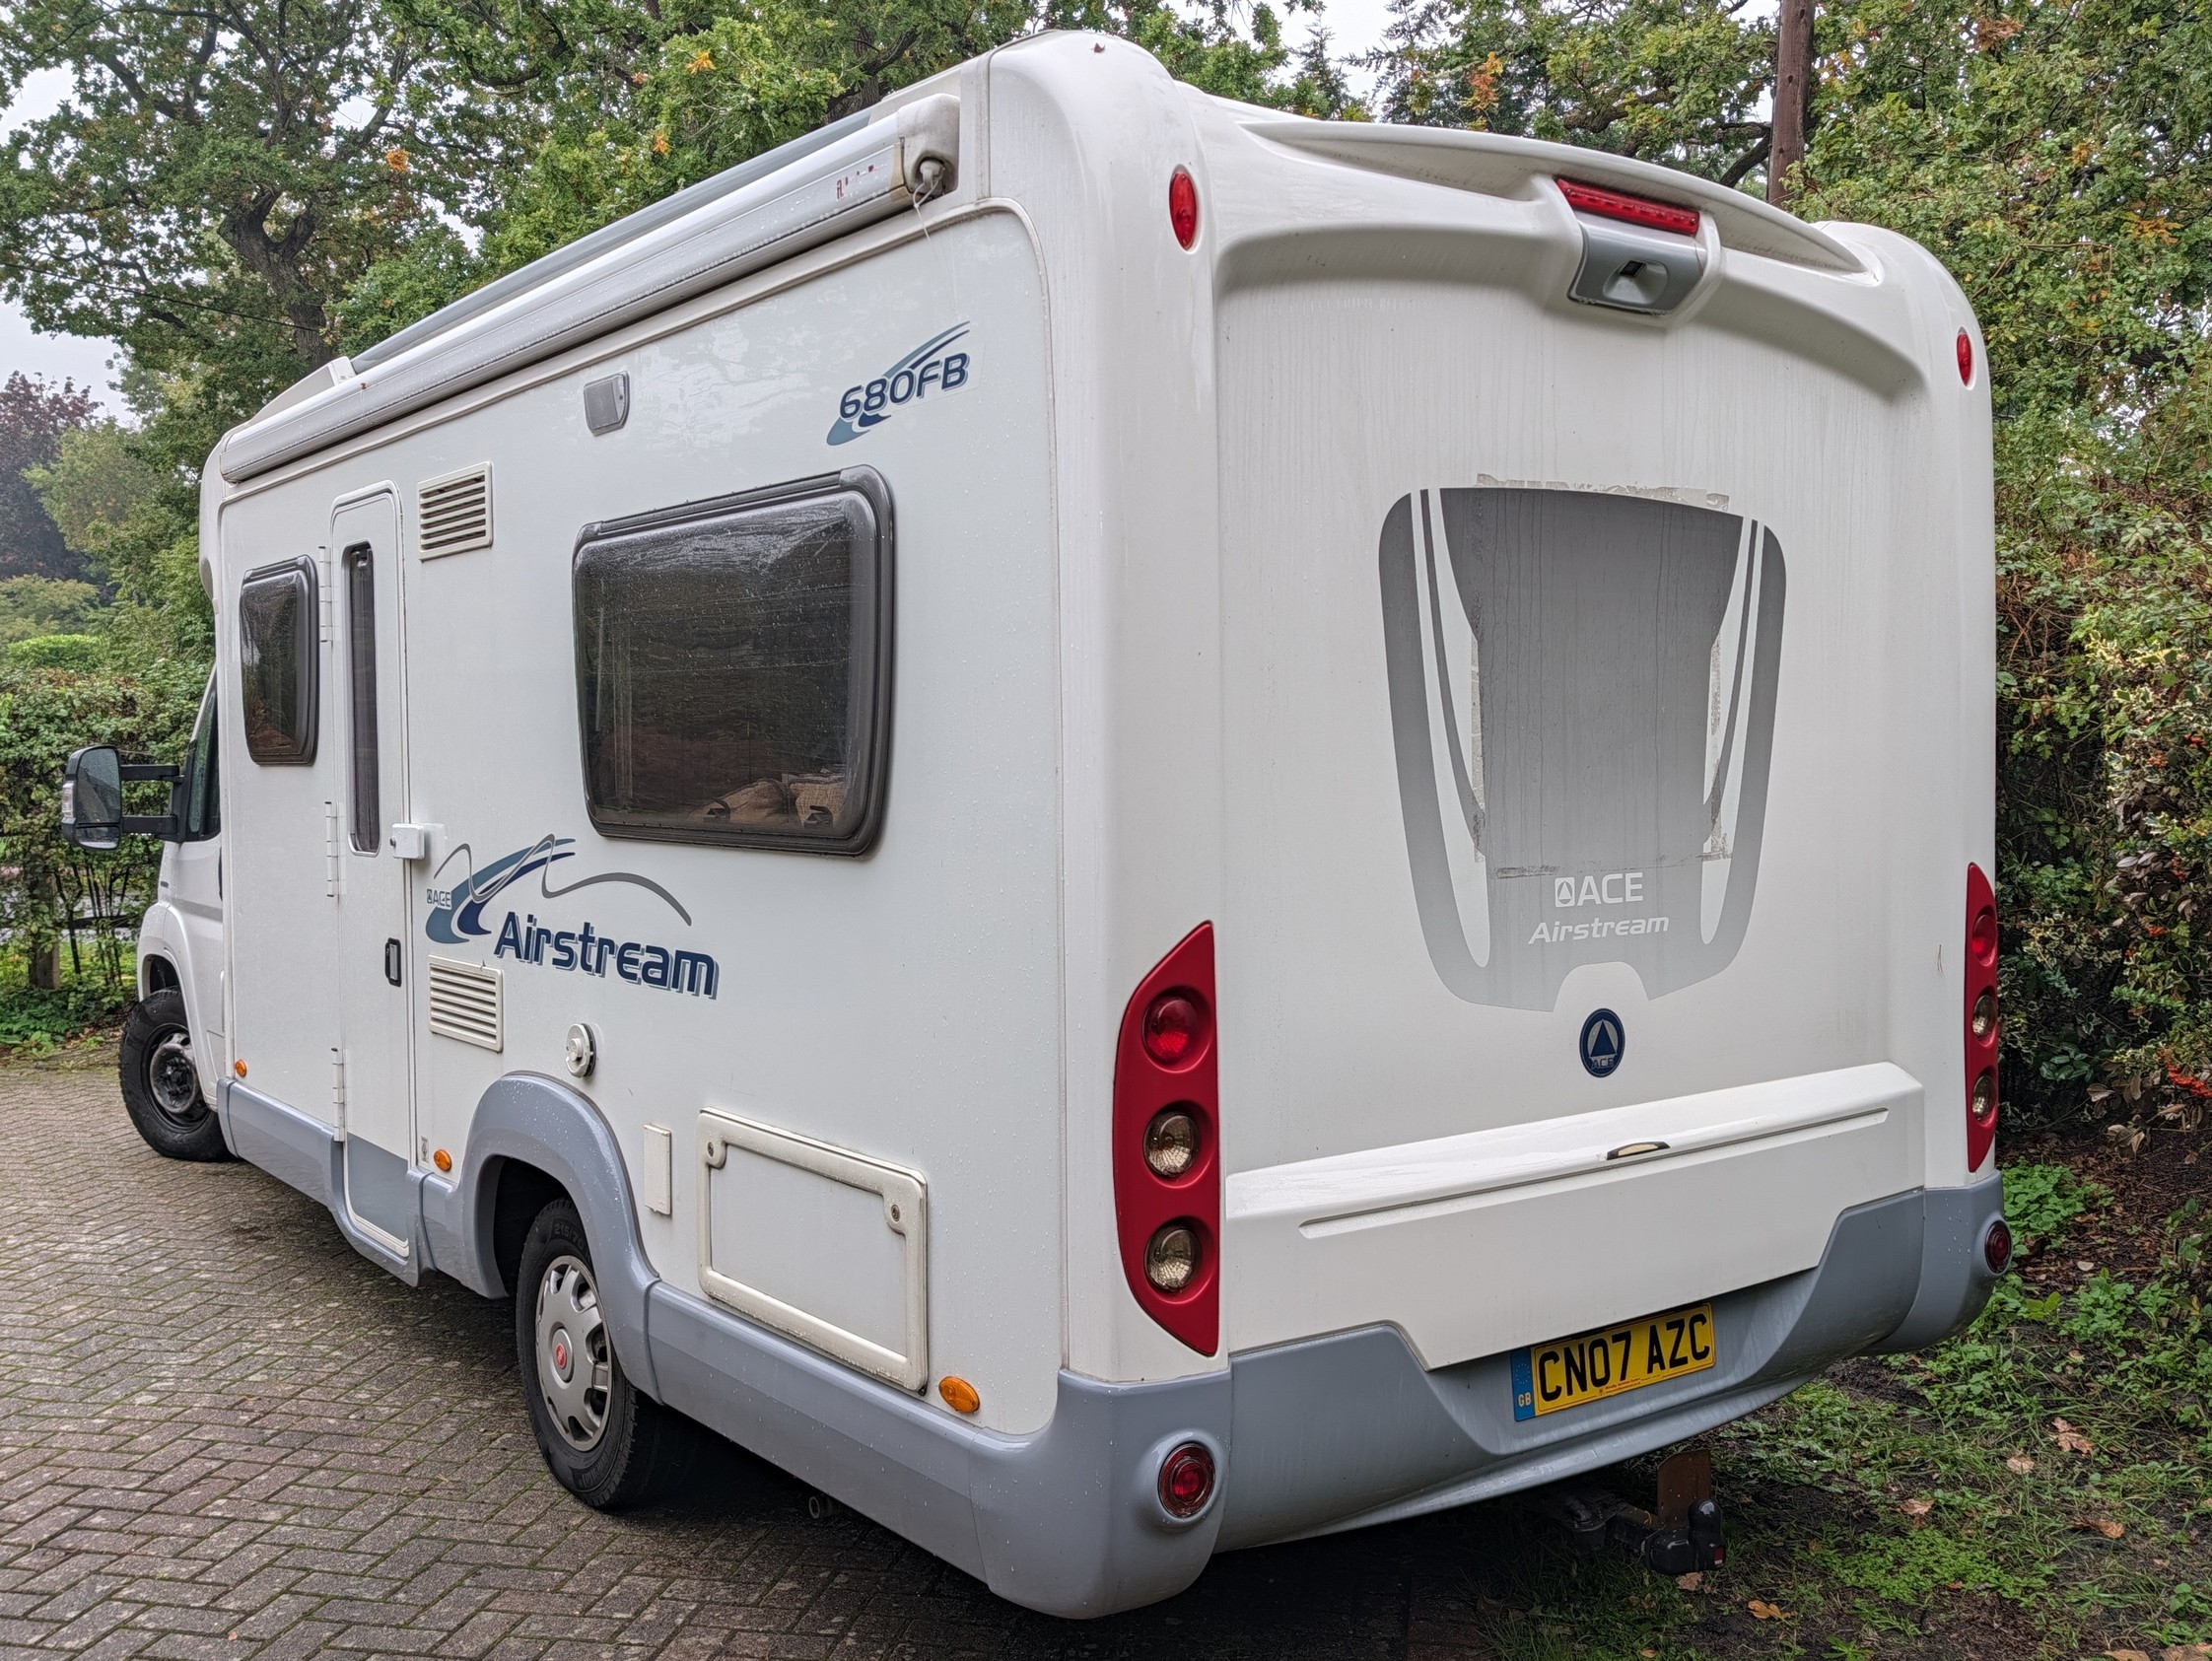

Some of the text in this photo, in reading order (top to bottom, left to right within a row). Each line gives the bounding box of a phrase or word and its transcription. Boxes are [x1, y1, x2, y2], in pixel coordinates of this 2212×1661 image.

[840, 352, 970, 419] 680FB
[433, 889, 451, 907] ACE
[1577, 872, 1643, 906] ACE
[1528, 916, 1670, 944] Airstream
[494, 911, 720, 1000] Airstream
[1592, 1058, 1614, 1069] ACE
[1538, 1313, 1710, 1402] CN07 AZC
[1518, 1391, 1532, 1408] GB
